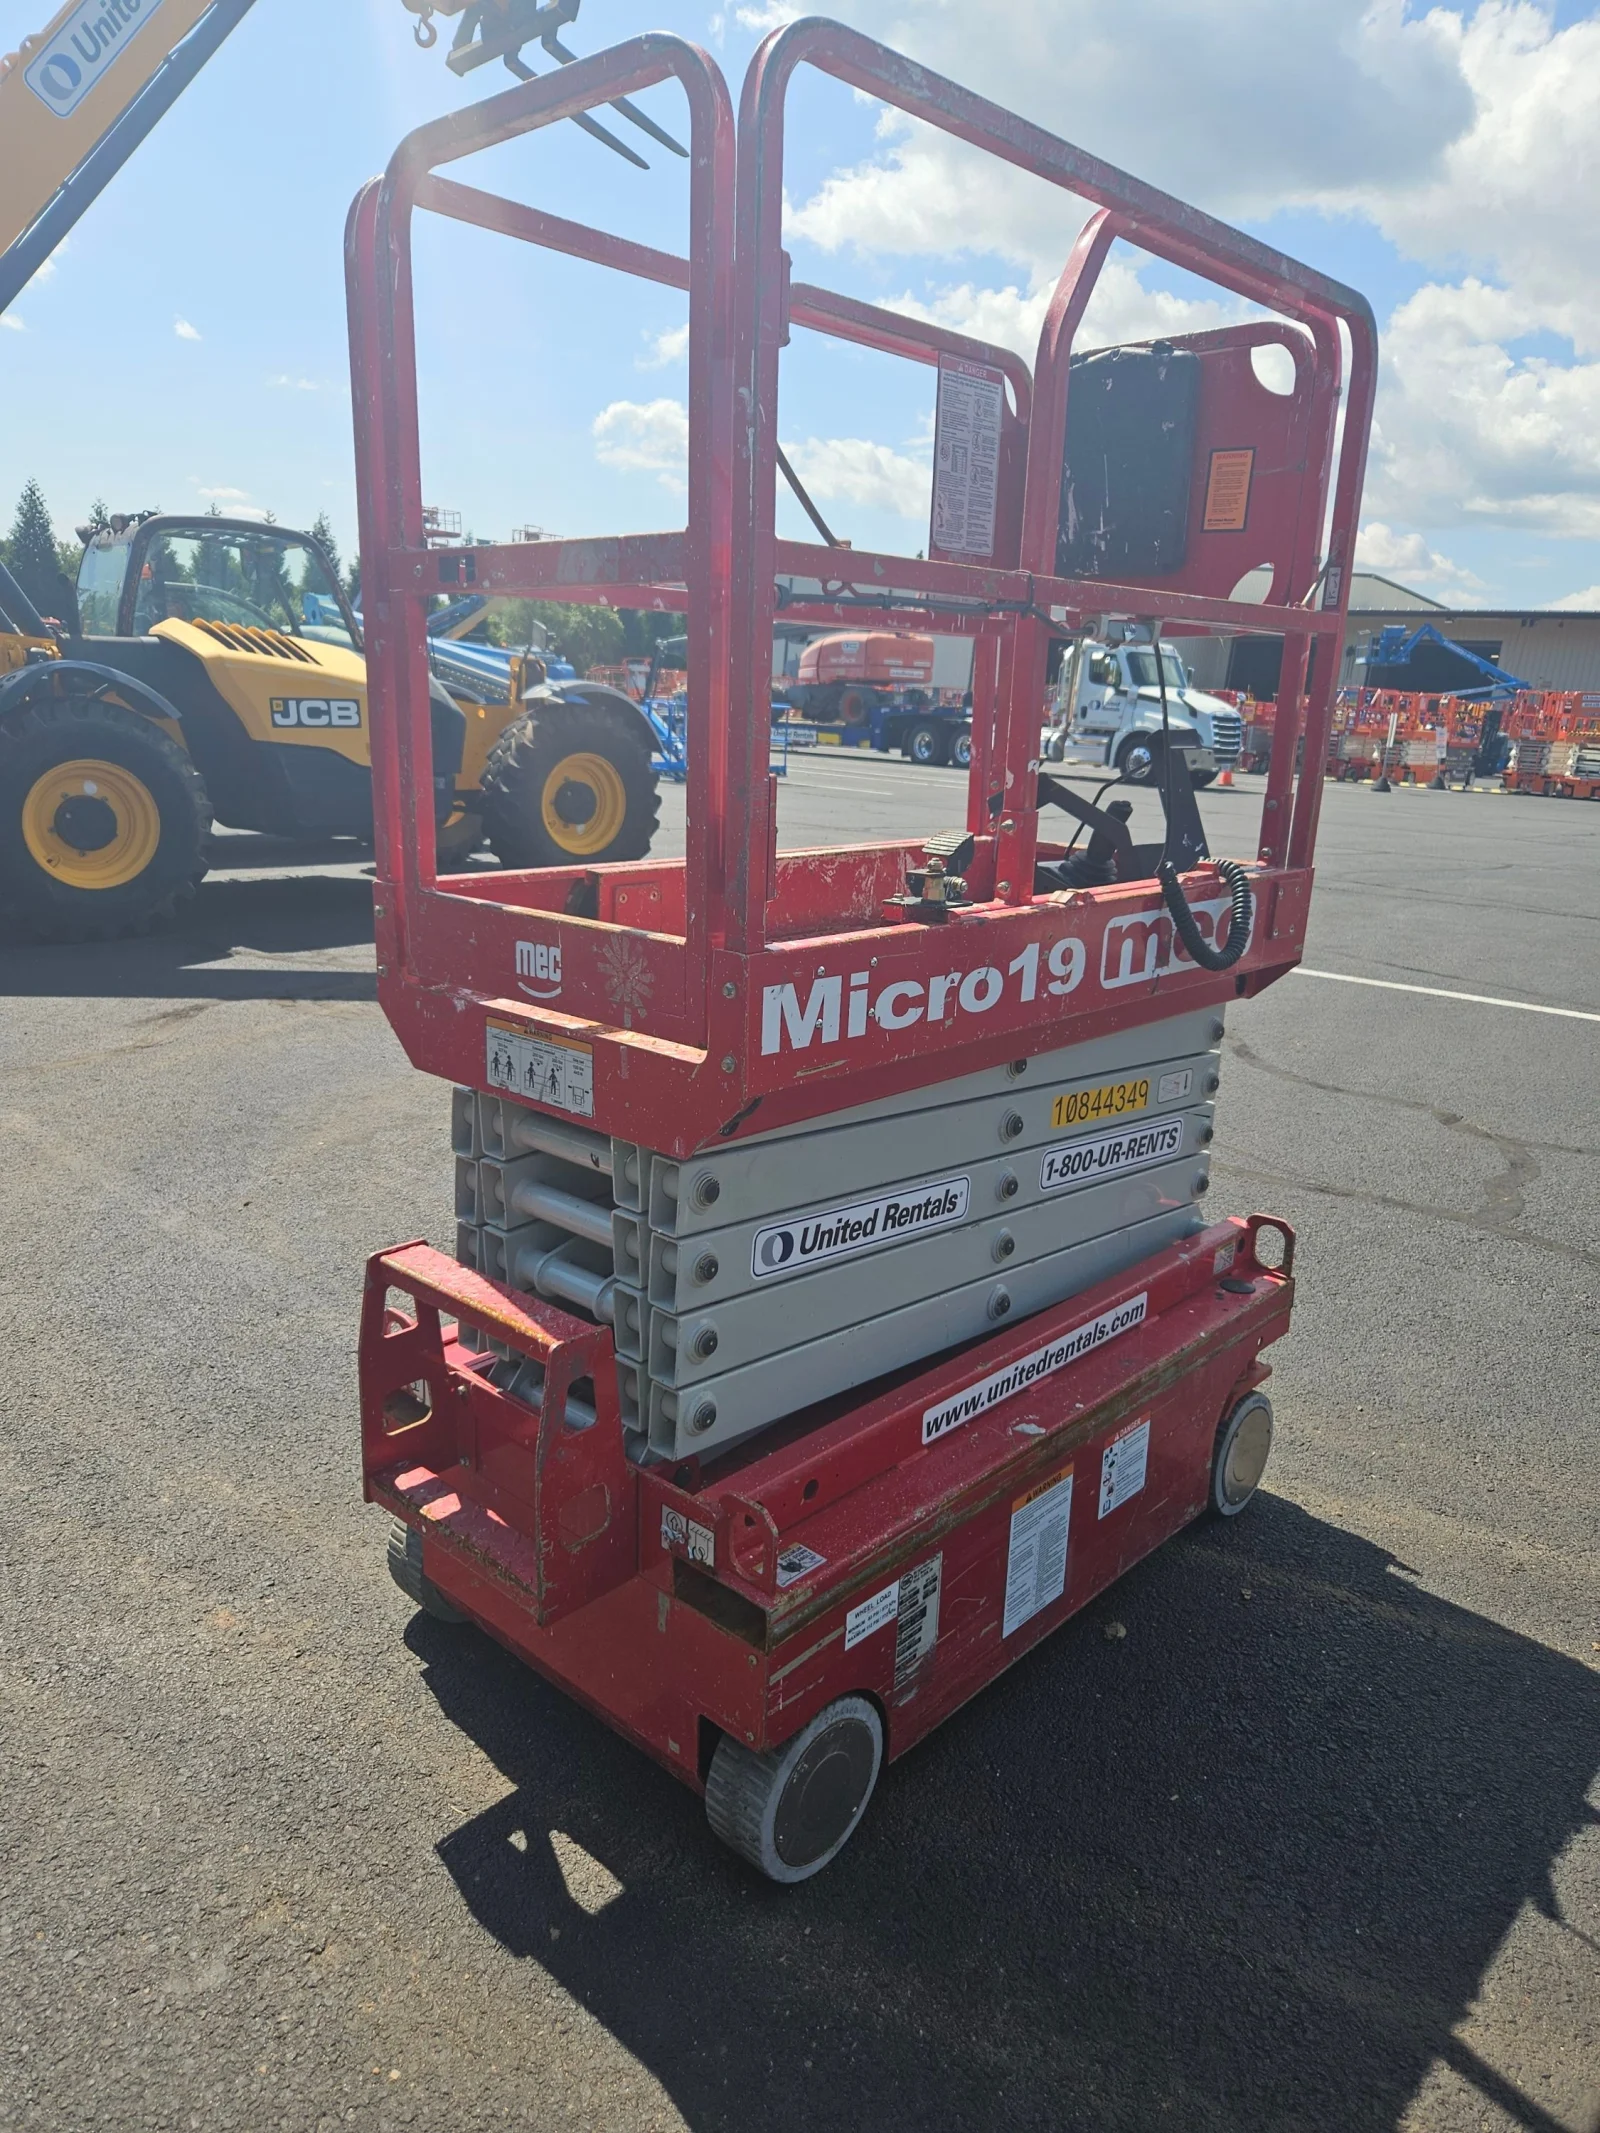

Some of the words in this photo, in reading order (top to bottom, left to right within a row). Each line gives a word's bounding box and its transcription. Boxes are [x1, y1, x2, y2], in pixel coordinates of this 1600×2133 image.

[273, 700, 360, 726] JCB
[1055, 1079, 1149, 1125] 10844349
[1046, 1127, 1179, 1181] 1-800-UR-RENTS
[799, 1208, 880, 1255] United
[925, 1301, 1145, 1438] www.unitedrentals.com
[1119, 1418, 1141, 1438] DANGER
[1032, 1472, 1062, 1497] WARNING
[855, 1603, 874, 1619] WHEEL
[876, 1591, 892, 1605] LOAD
